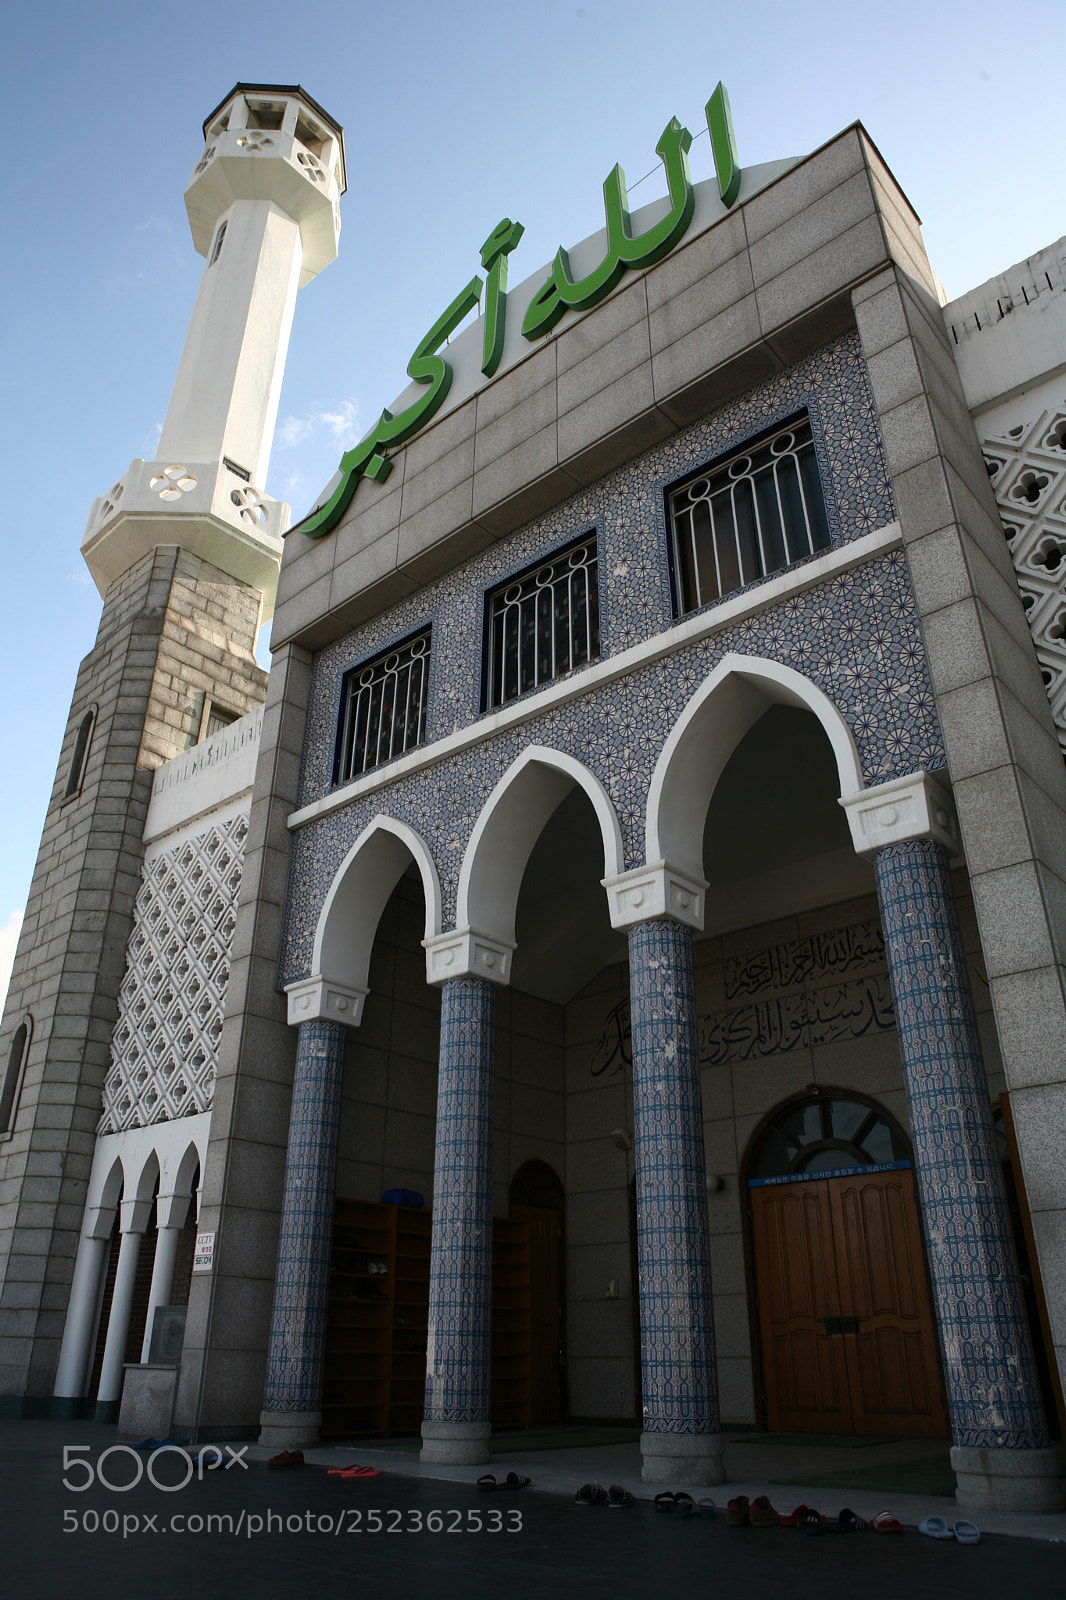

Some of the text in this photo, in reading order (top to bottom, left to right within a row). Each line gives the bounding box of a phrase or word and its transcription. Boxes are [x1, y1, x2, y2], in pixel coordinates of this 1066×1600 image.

[297, 80, 741, 538] الله أكبر
[197, 1235, 213, 1245] CCTV
